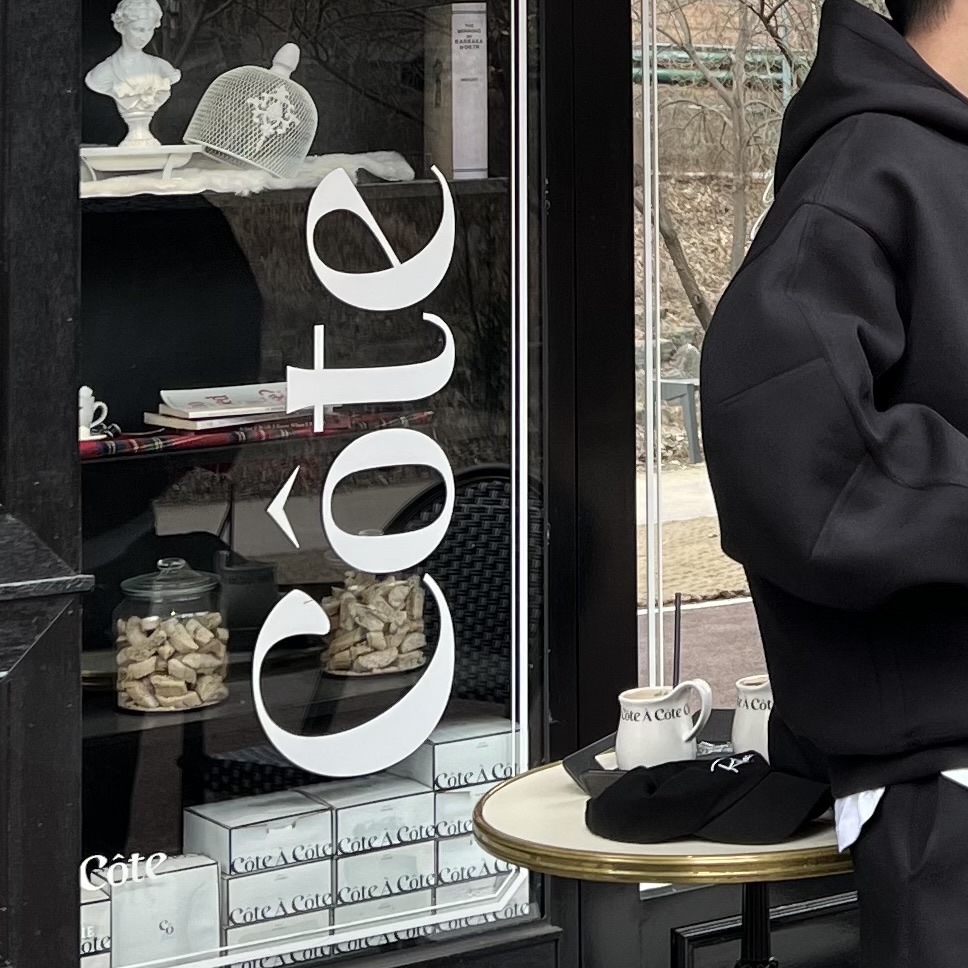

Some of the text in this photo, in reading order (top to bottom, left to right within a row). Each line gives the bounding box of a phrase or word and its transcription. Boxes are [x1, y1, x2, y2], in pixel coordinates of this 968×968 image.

[251, 164, 456, 777] Côte
[751, 697, 771, 711] Côt
[491, 762, 519, 781] Côt
[338, 835, 379, 856] Côte
[396, 823, 436, 844] Côte
[80, 852, 168, 891] Côte
[230, 854, 273, 874] Côte
[292, 842, 333, 863] Côte
[338, 884, 380, 904] Côte
[397, 873, 436, 894] Côte
[438, 866, 482, 888] Côte
[229, 904, 272, 926] Côte
[292, 892, 333, 913] Côte
